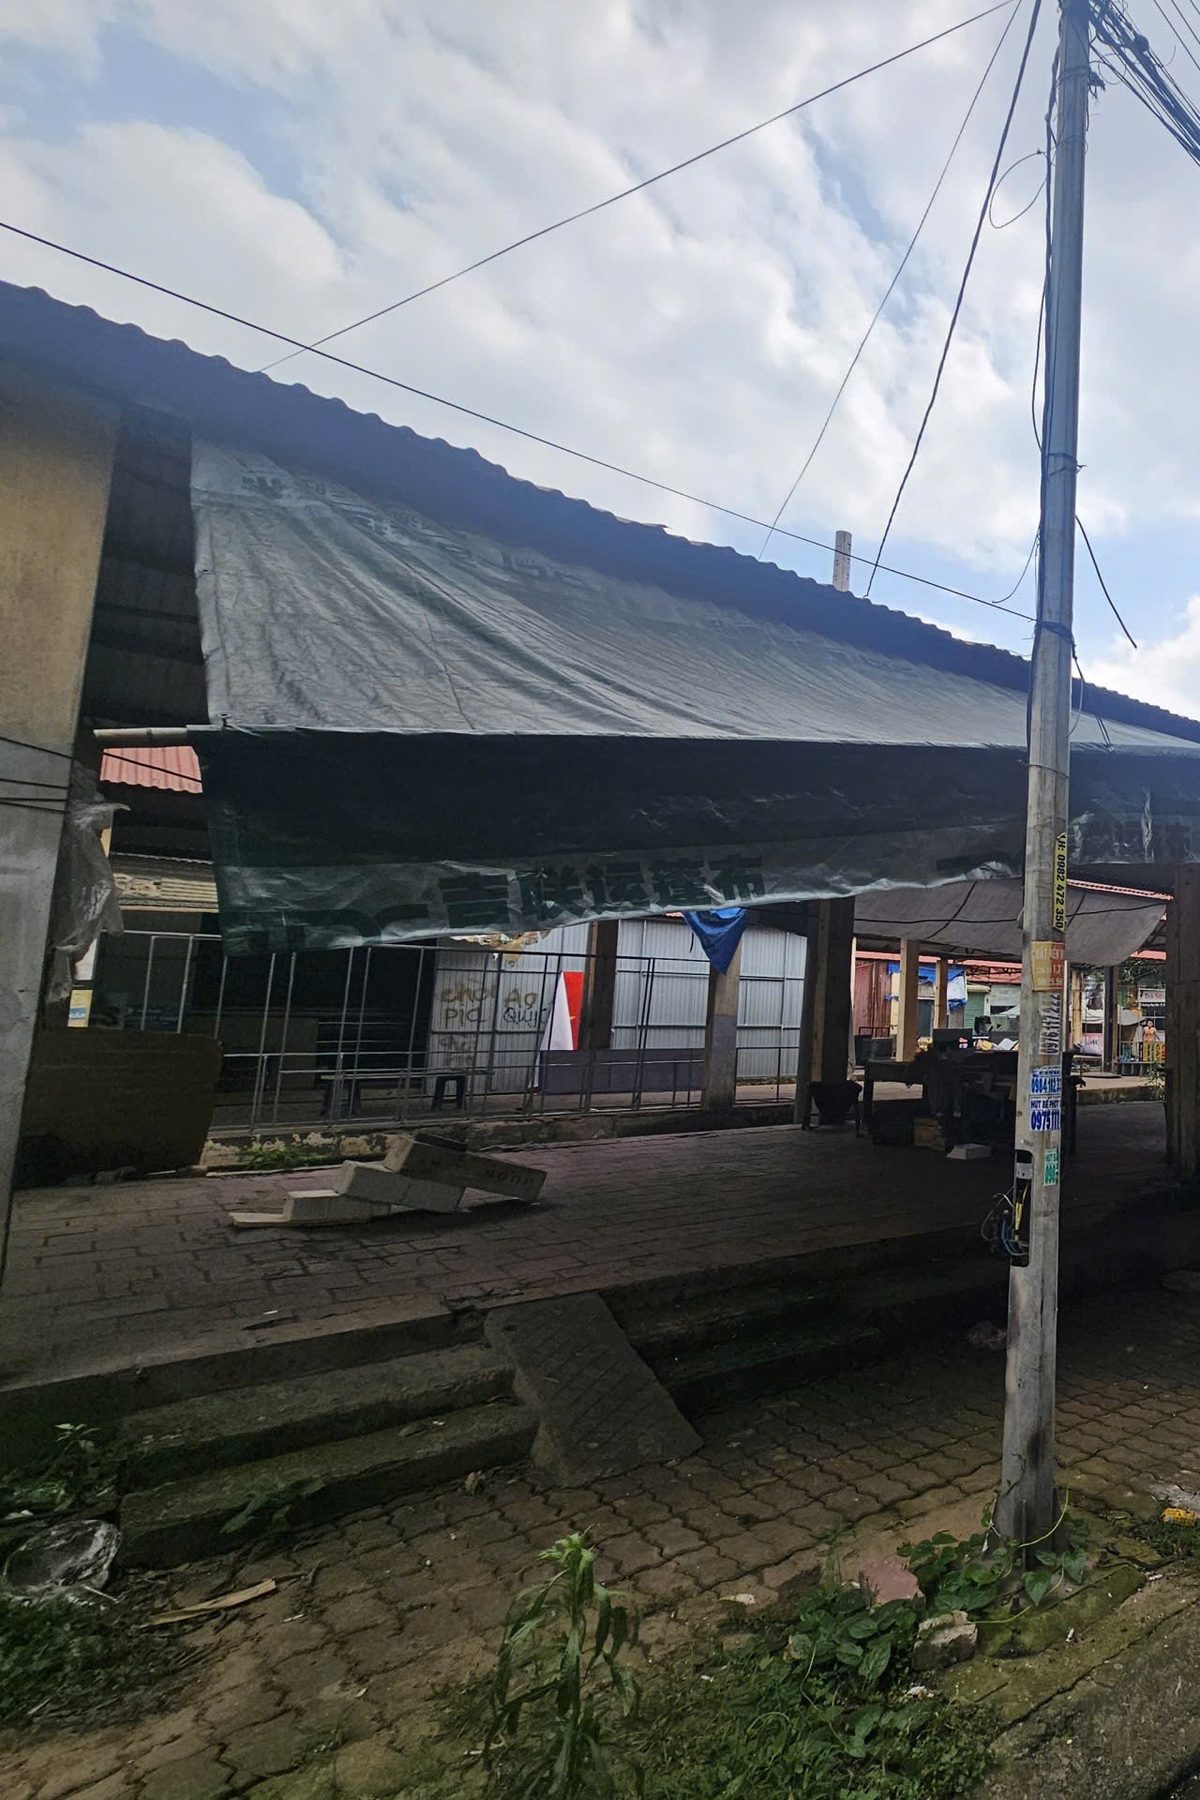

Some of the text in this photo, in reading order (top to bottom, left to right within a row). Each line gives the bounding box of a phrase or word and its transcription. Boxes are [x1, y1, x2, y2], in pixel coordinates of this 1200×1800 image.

[1056, 854, 1066, 882] 0982
[1056, 885, 1065, 905] 472
[1055, 911, 1064, 929] 350
